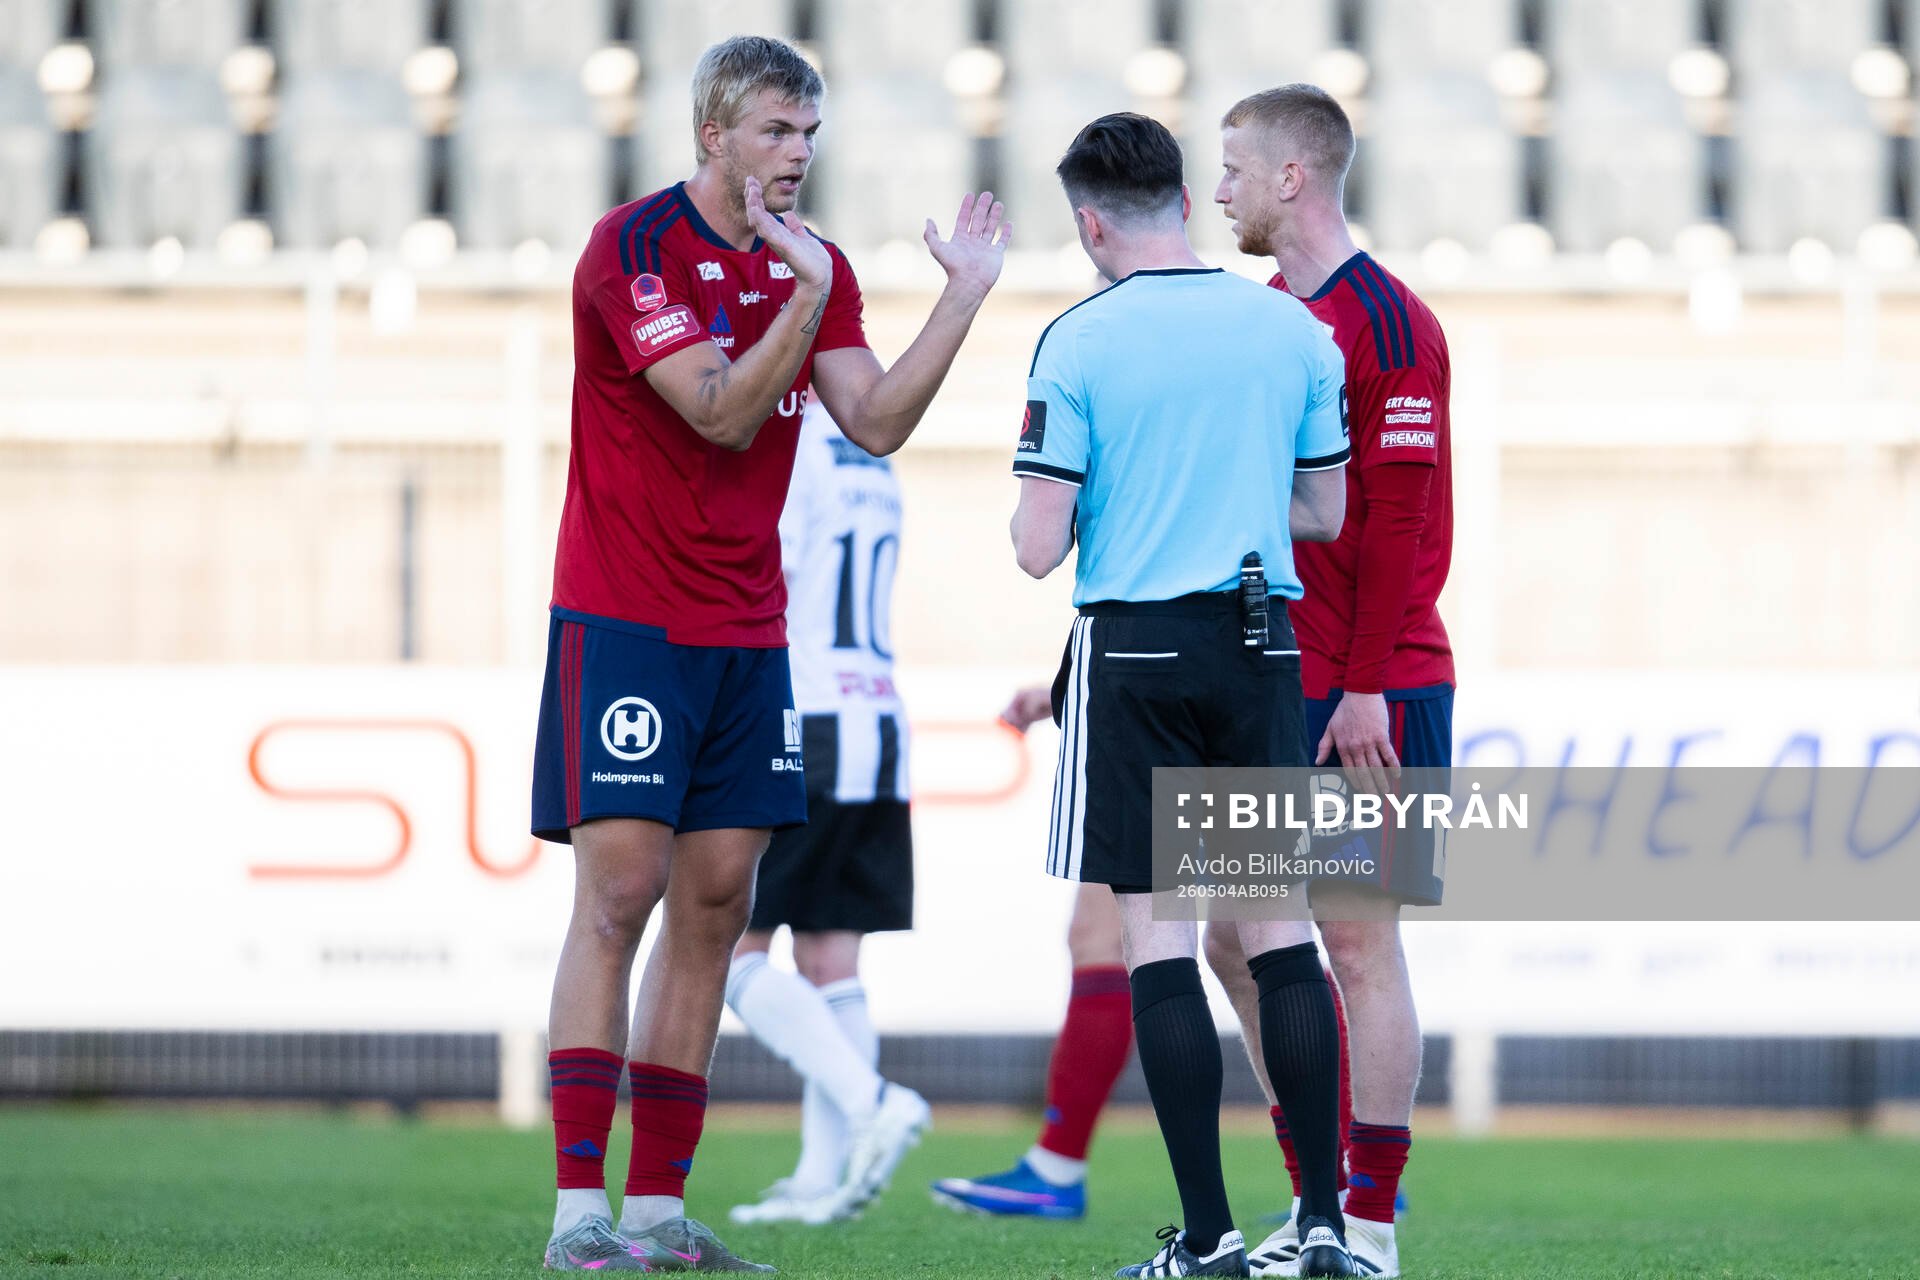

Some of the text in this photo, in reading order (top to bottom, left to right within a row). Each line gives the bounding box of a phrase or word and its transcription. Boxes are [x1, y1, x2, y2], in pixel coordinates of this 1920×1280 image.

[636, 311, 689, 341] UNIBET
[777, 390, 808, 417] US
[1385, 397, 1404, 409] ERT
[1382, 432, 1434, 446] PREMON
[833, 530, 899, 660] 10
[771, 758, 804, 771] BAL
[592, 771, 665, 785] Holmgrens Bil
